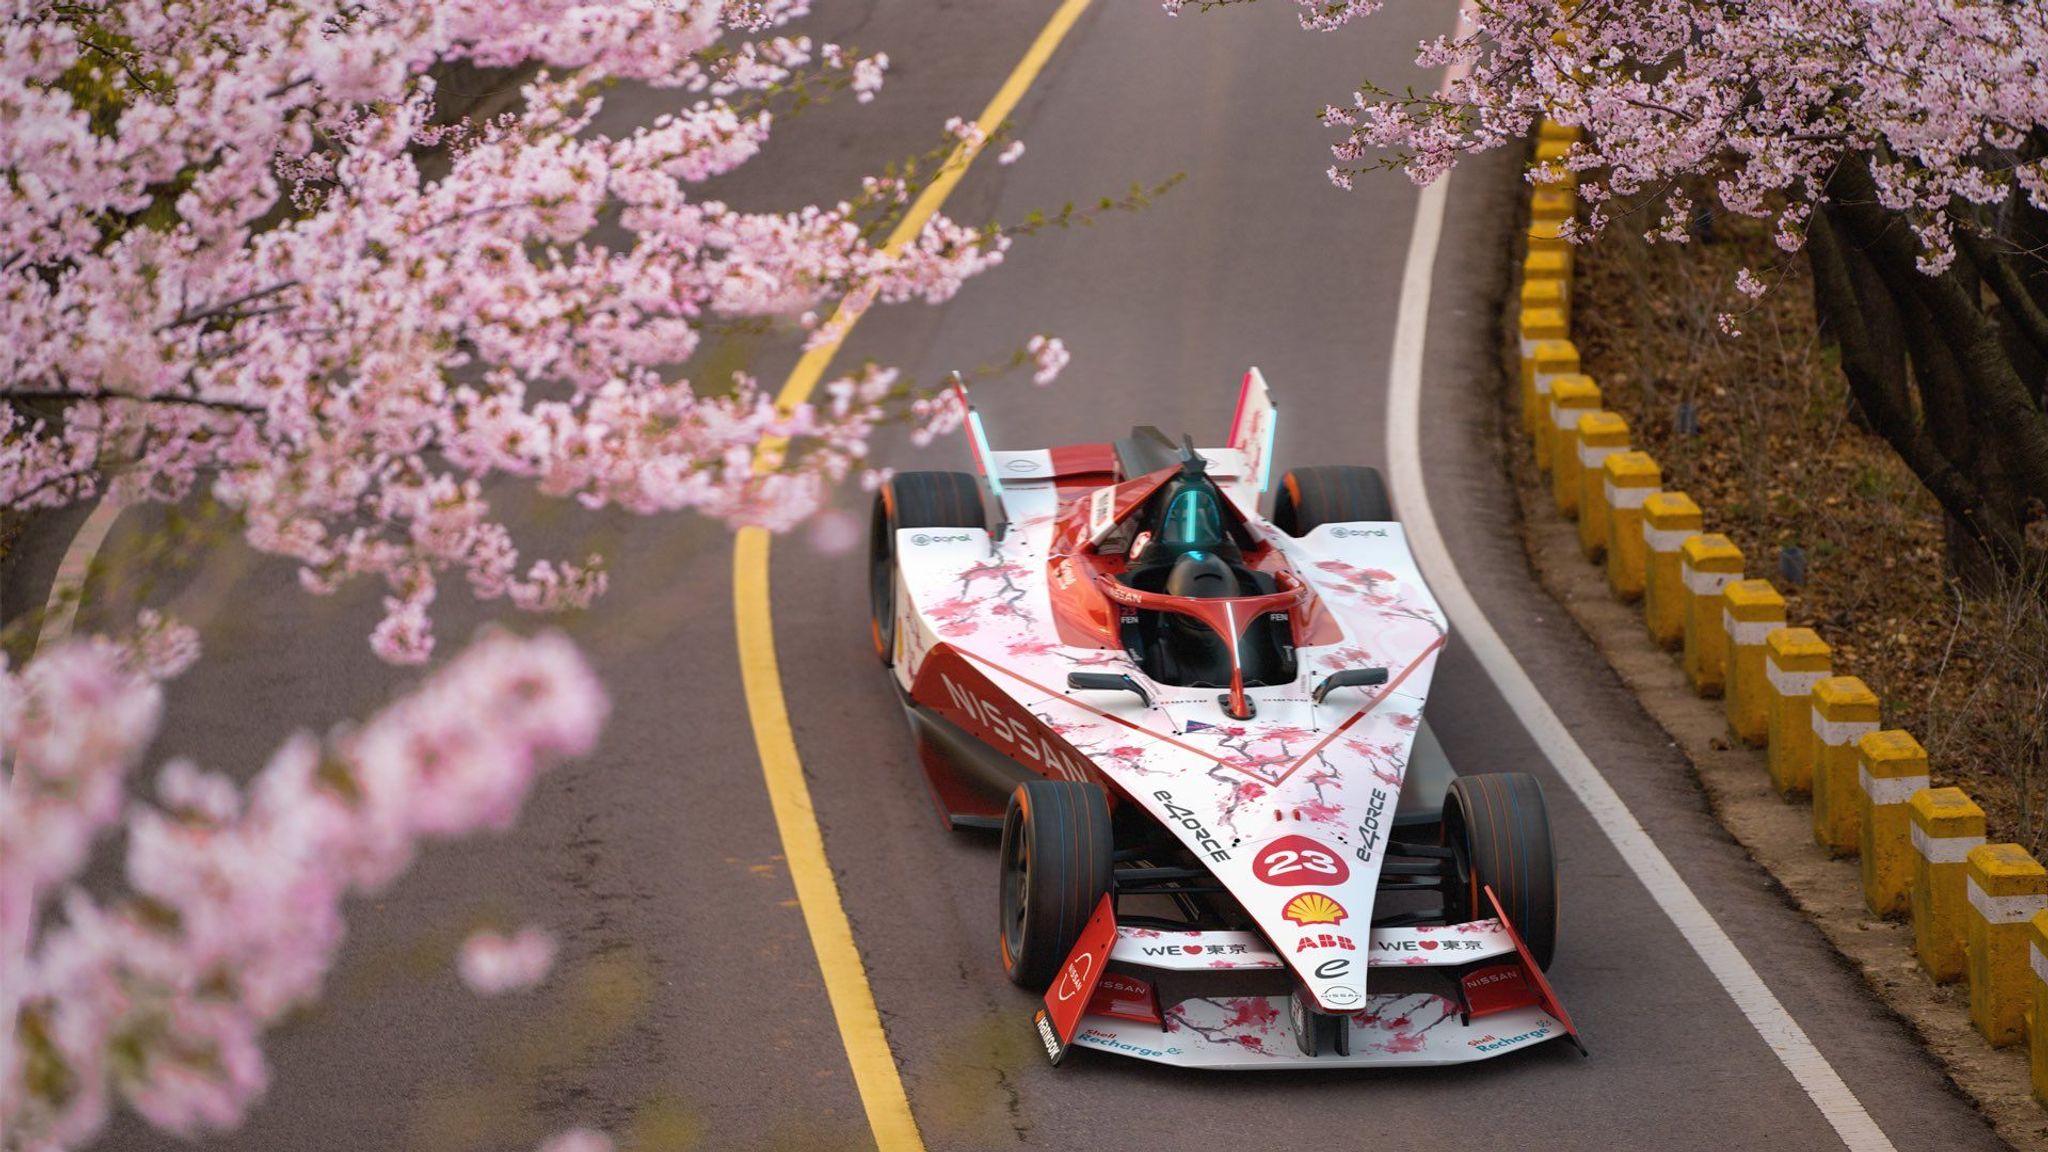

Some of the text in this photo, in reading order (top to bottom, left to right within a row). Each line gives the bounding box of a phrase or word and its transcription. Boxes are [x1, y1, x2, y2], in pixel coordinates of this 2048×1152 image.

[941, 673, 1088, 783] NISSAN
[1264, 849, 1338, 877] 23
[1142, 945, 1182, 956] WE
[1296, 934, 1356, 953] ABB
[1378, 940, 1418, 951] WE
[1068, 963, 1083, 992] NISSAN
[1467, 971, 1518, 989] NISSAN
[1099, 981, 1145, 994] ISSAN
[1085, 1029, 1118, 1039] Shell
[1467, 1032, 1496, 1047] Shell
[1475, 1027, 1551, 1053] Recharge
[1078, 1033, 1163, 1057] Recharge
